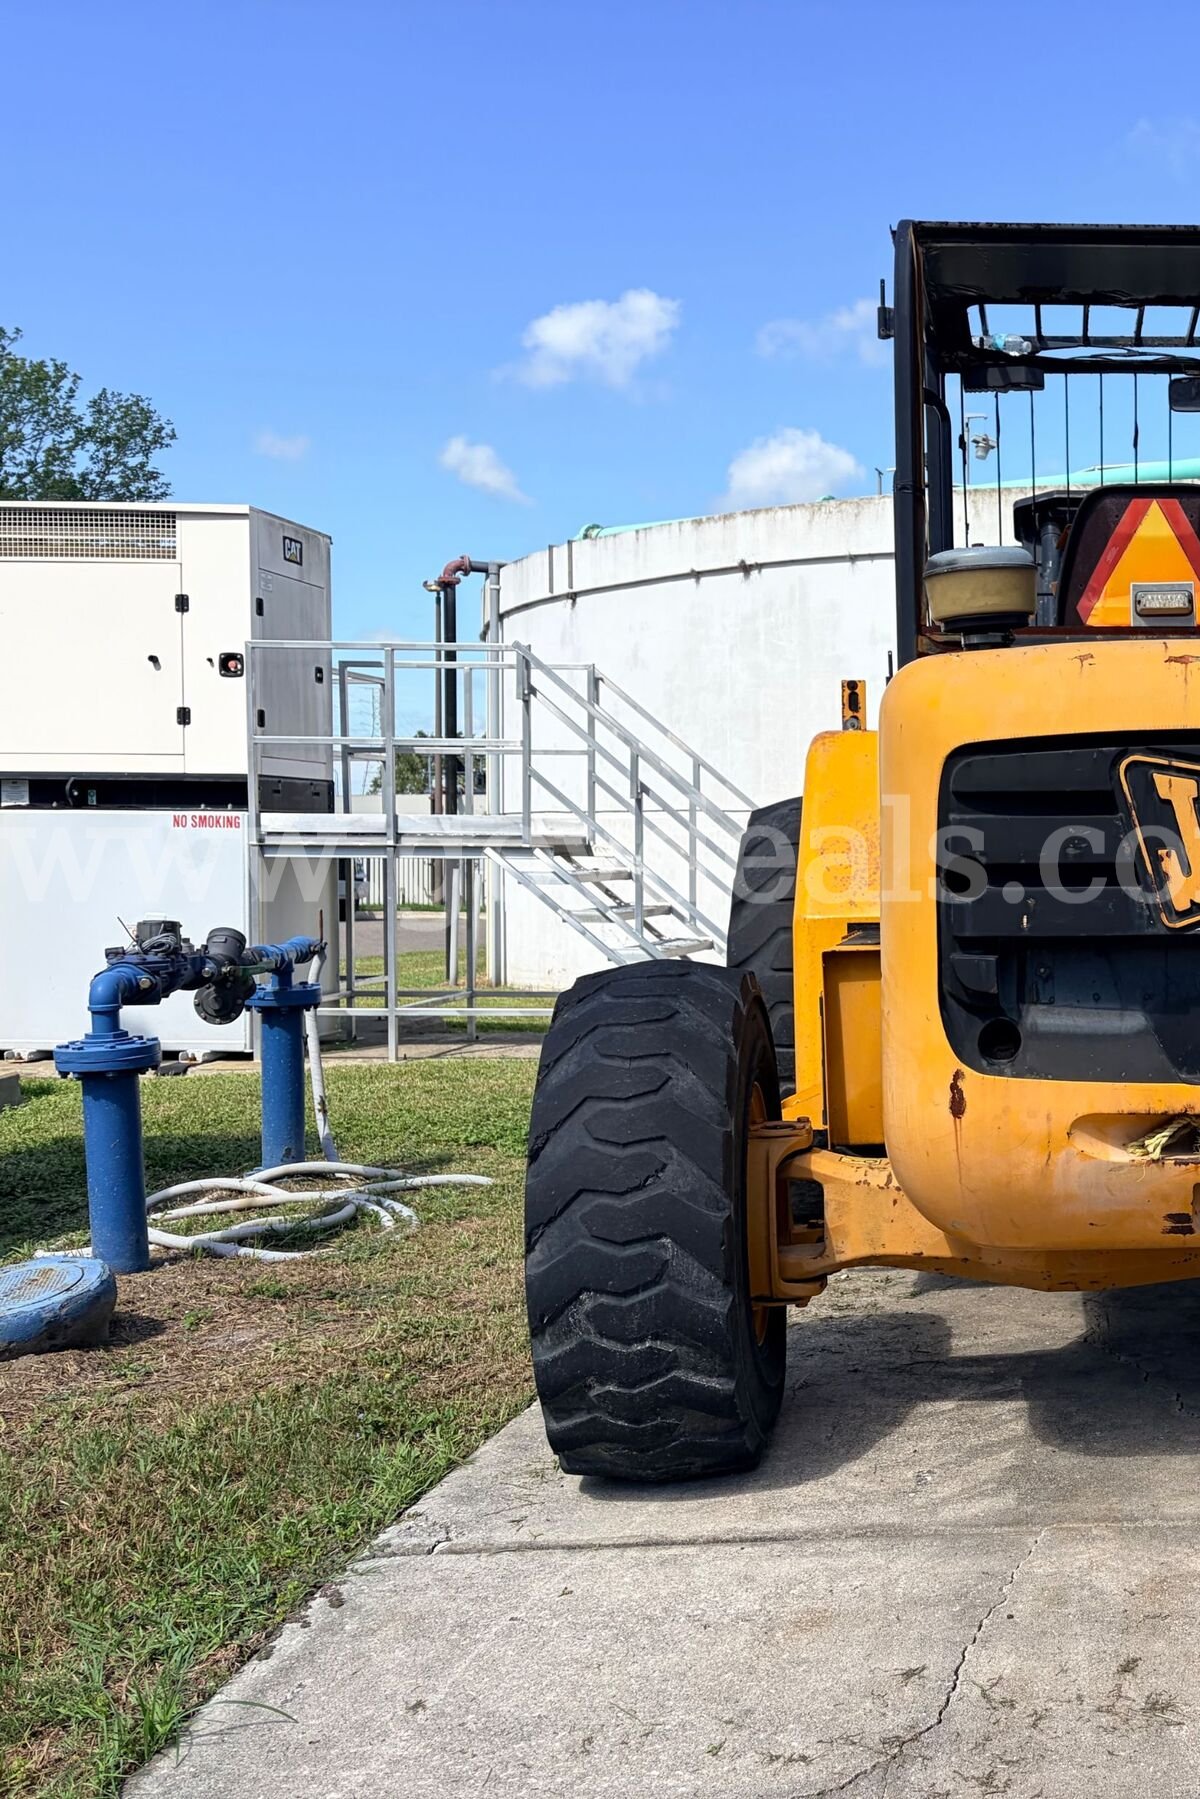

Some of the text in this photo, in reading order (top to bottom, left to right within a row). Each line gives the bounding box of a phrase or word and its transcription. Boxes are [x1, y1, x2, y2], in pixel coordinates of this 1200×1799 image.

[284, 537, 302, 562] CAT
[172, 814, 241, 829] NO SMOKING
